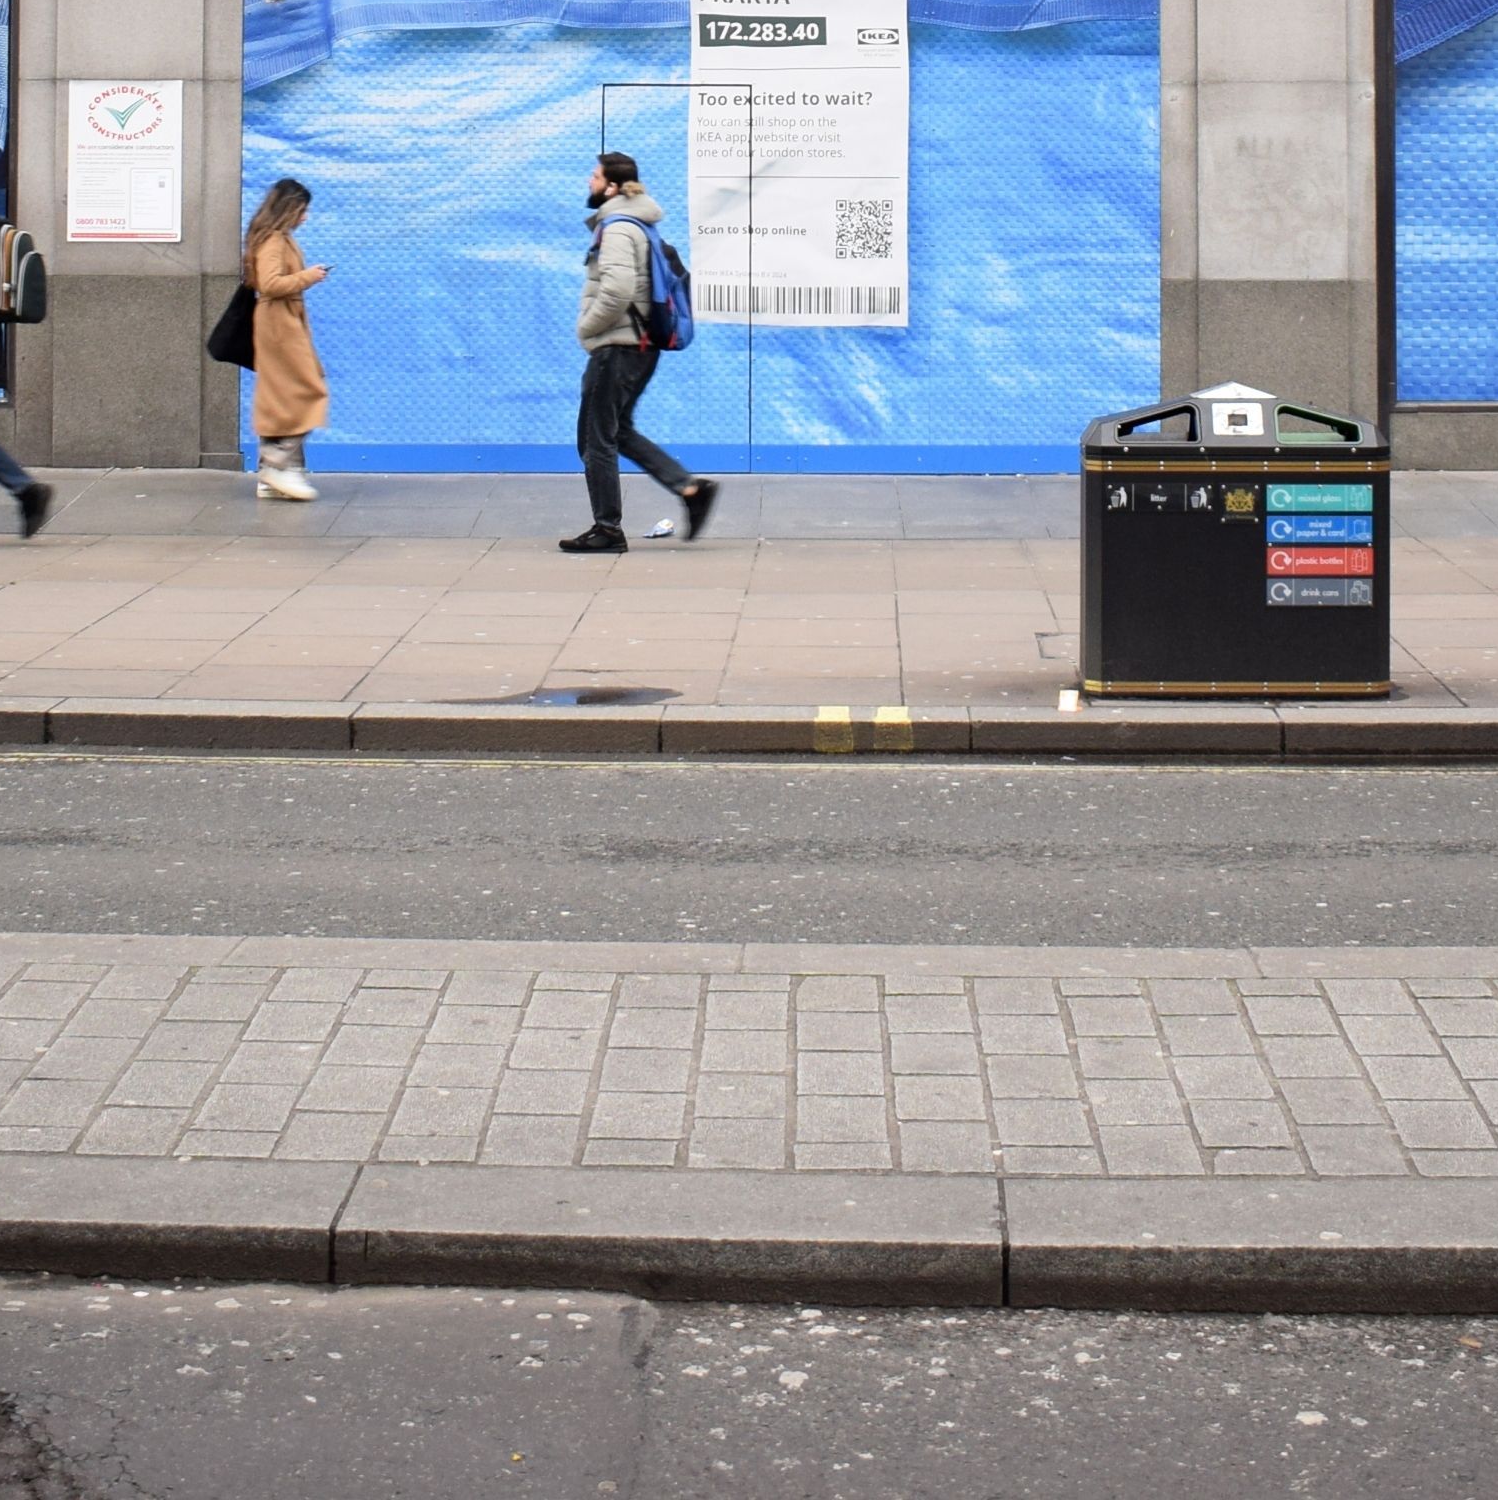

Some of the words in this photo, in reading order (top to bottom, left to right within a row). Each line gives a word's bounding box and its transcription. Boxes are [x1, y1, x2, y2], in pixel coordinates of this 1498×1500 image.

[706, 21, 820, 42] 172.283.40
[88, 85, 164, 112] CONSIDERATE
[698, 92, 728, 106] Too
[733, 91, 796, 106] excited
[802, 92, 820, 106] to
[825, 91, 873, 106] wait?
[696, 117, 717, 127] You
[721, 118, 741, 127] can
[744, 117, 765, 127] still
[767, 116, 797, 129] shop
[799, 118, 815, 127] on
[818, 116, 837, 127] the
[87, 116, 163, 141] CONSTRUCTORS
[696, 132, 722, 142] IKEA
[754, 132, 799, 143] website
[802, 133, 814, 142] or
[817, 132, 841, 143] visit
[696, 149, 718, 158] one
[721, 147, 734, 158] of
[736, 149, 756, 158] our
[760, 147, 804, 158] London
[807, 148, 846, 158] stores.
[697, 225, 724, 235] Scan
[727, 226, 739, 235] to
[771, 226, 807, 236] online
[1150, 493, 1168, 502] litter
[1297, 493, 1320, 502] mixed
[1322, 493, 1342, 504] glass
[1308, 520, 1332, 528] mixed
[1296, 530, 1319, 538] paper
[1320, 528, 1327, 537] &
[1328, 528, 1345, 537] card
[1295, 557, 1319, 566] plastic
[1319, 556, 1344, 565] bottles
[1300, 588, 1321, 597] drink
